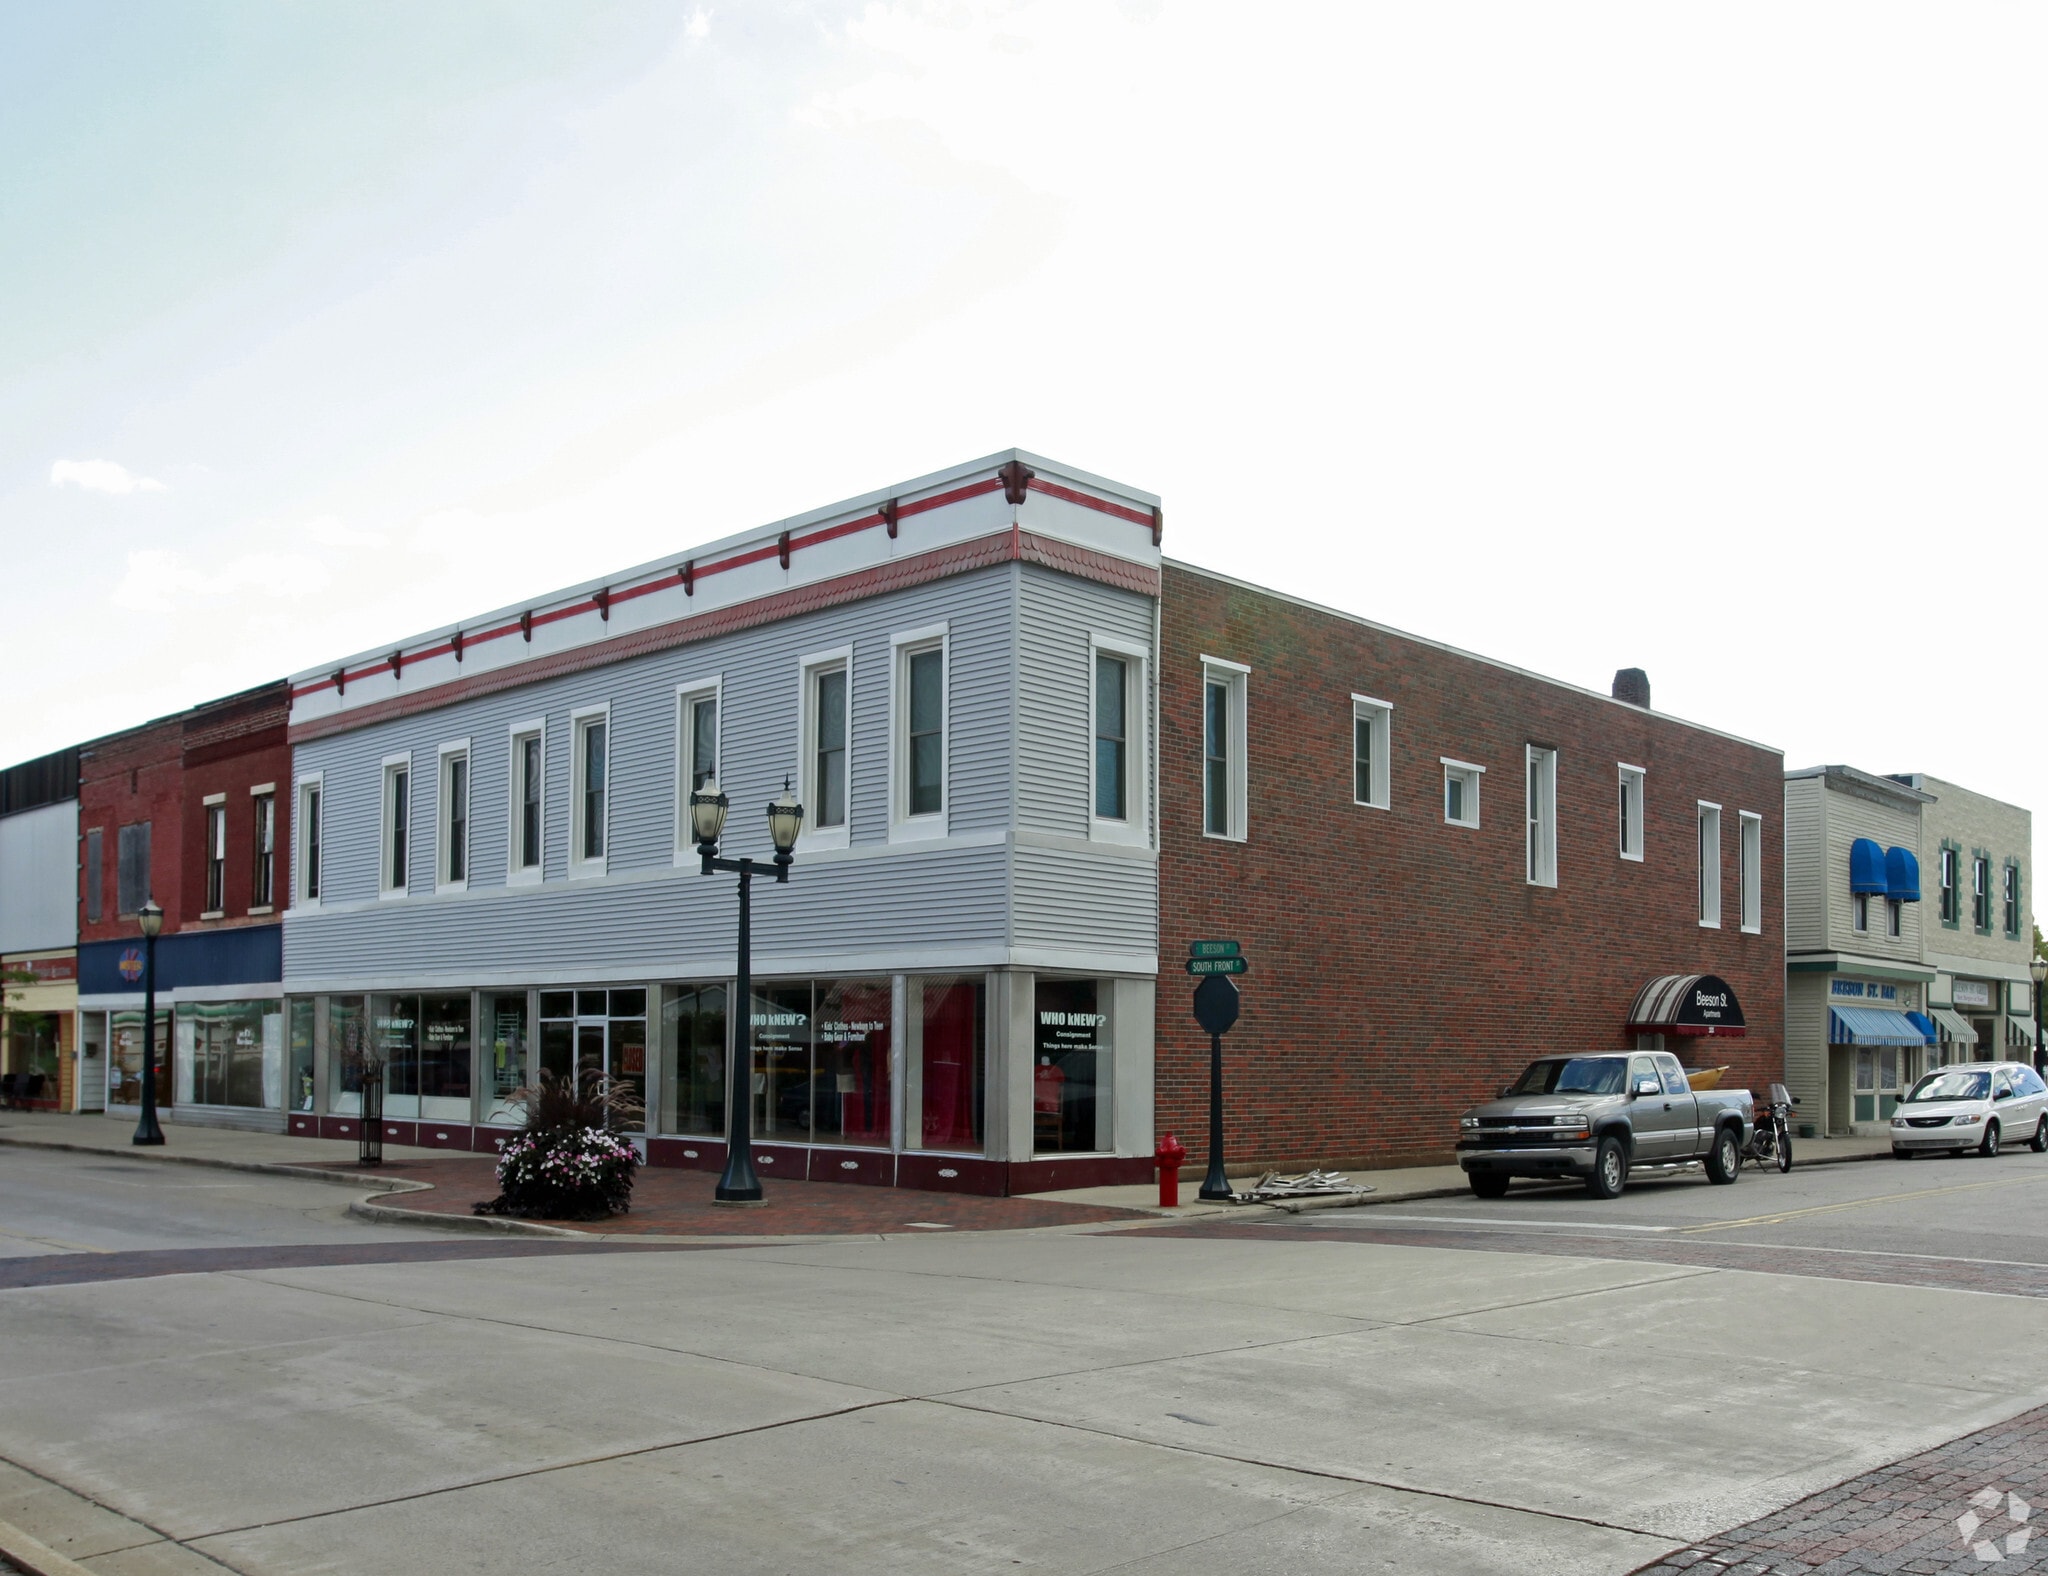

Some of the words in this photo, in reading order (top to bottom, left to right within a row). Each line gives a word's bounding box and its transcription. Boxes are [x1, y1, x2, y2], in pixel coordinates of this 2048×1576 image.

[1203, 943, 1225, 954] BEESON
[1192, 961, 1211, 972] SOUTH
[1214, 960, 1234, 971] FRONT
[1831, 979, 1864, 996] BEESON
[1866, 983, 1878, 998] ST.
[1881, 984, 1896, 1000] BAR
[1696, 990, 1720, 1006] Beeson
[1040, 1011, 1066, 1026] WHO
[1056, 1030, 1091, 1039] Consignment
[1043, 1042, 1060, 1050] Things
